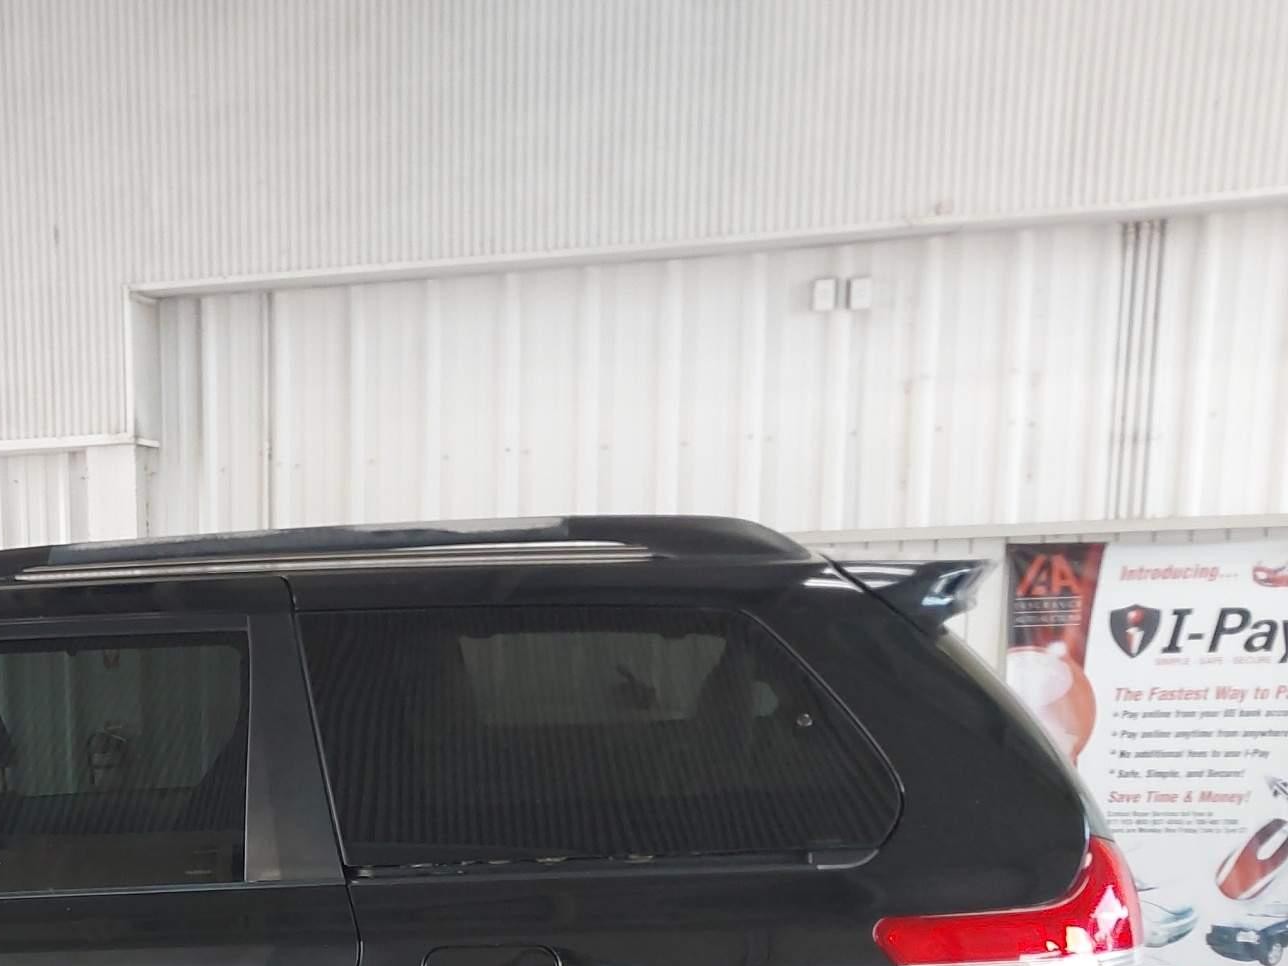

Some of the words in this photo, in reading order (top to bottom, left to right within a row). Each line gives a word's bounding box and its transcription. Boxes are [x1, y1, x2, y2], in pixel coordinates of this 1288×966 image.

[1115, 687, 1143, 701] The
[1148, 686, 1209, 701] Fastest
[1215, 686, 1247, 702] Way
[1253, 686, 1270, 700] to
[1108, 790, 1141, 803] Save
[1146, 790, 1179, 803] Time
[1183, 791, 1193, 803] &
[1198, 790, 1252, 805] Money!
